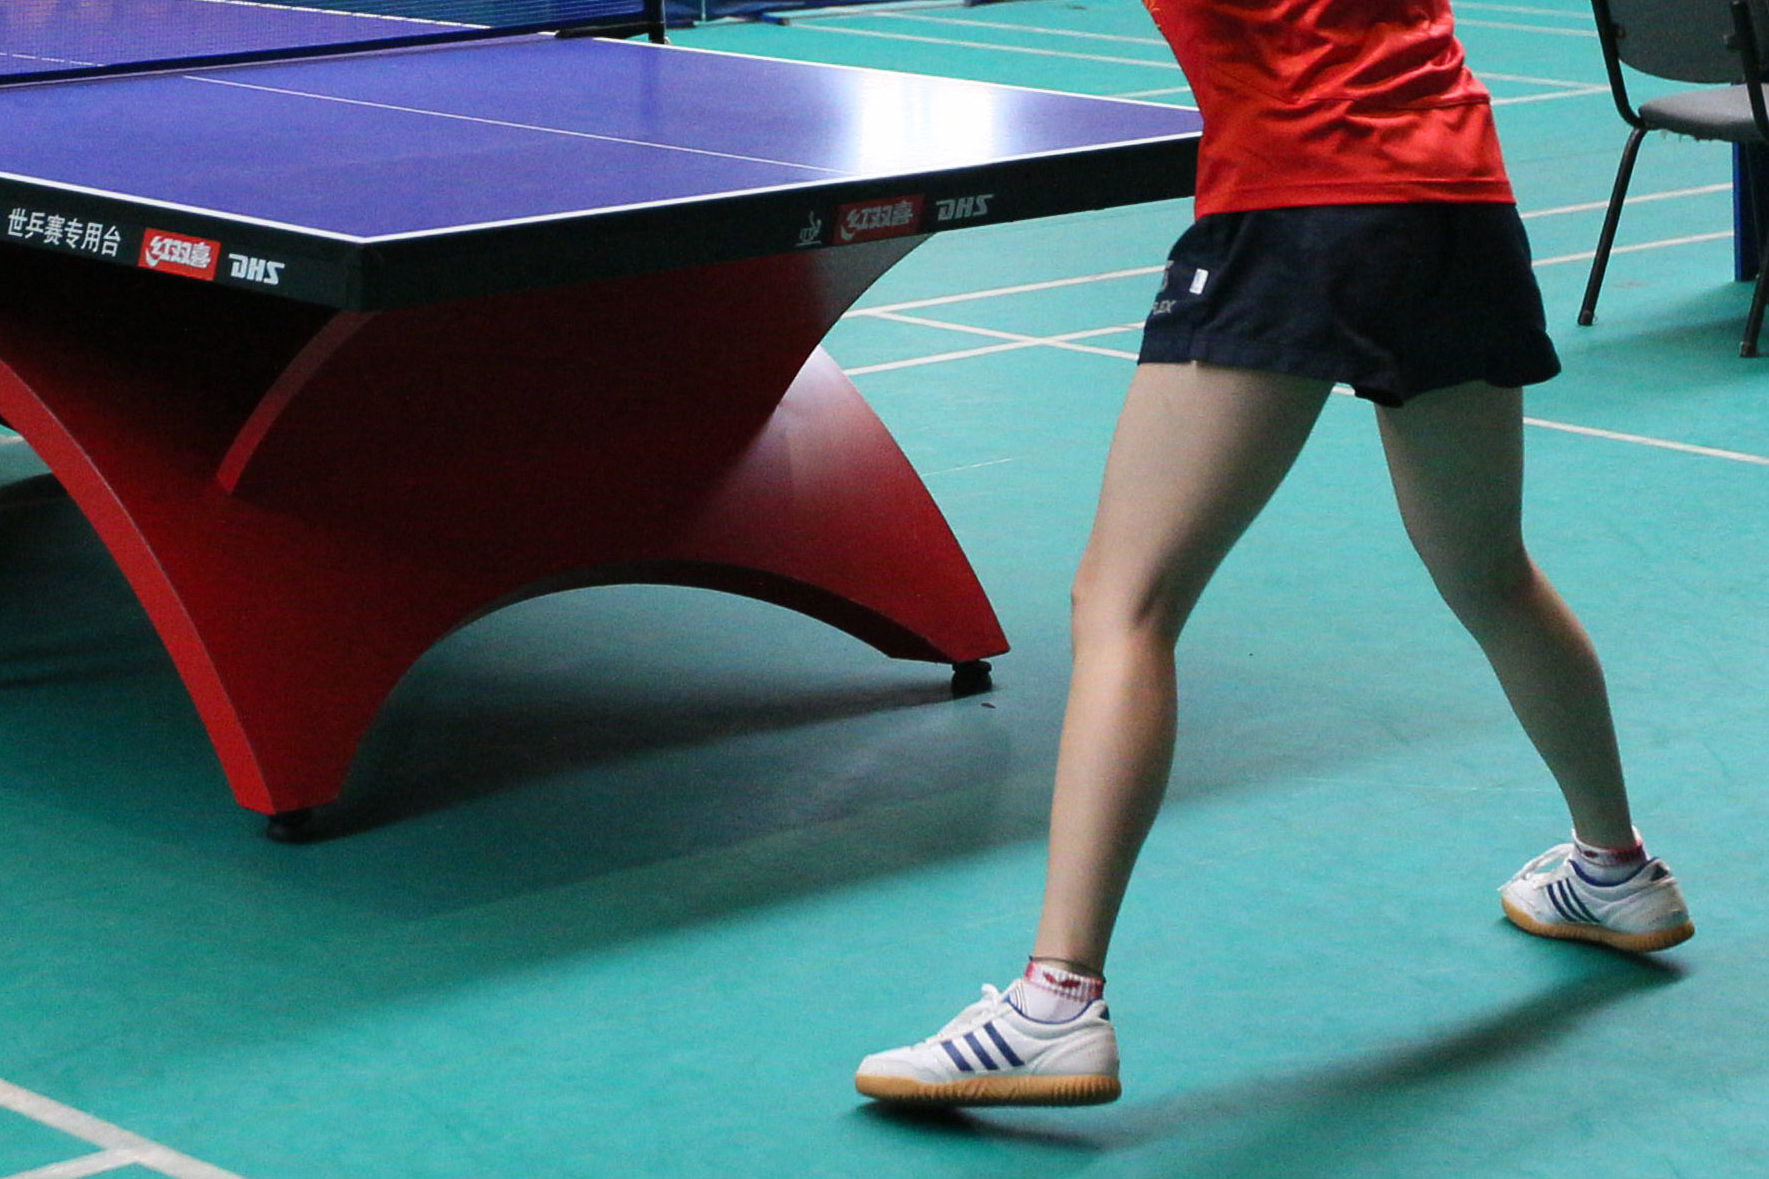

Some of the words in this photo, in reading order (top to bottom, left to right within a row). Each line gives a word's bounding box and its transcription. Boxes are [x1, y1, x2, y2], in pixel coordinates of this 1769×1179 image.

[839, 199, 914, 242] 红双喜
[935, 193, 995, 221] DHS
[7, 207, 122, 258] 世乒赛专用台
[144, 234, 212, 269] 红双喜
[227, 252, 286, 287] DHS
